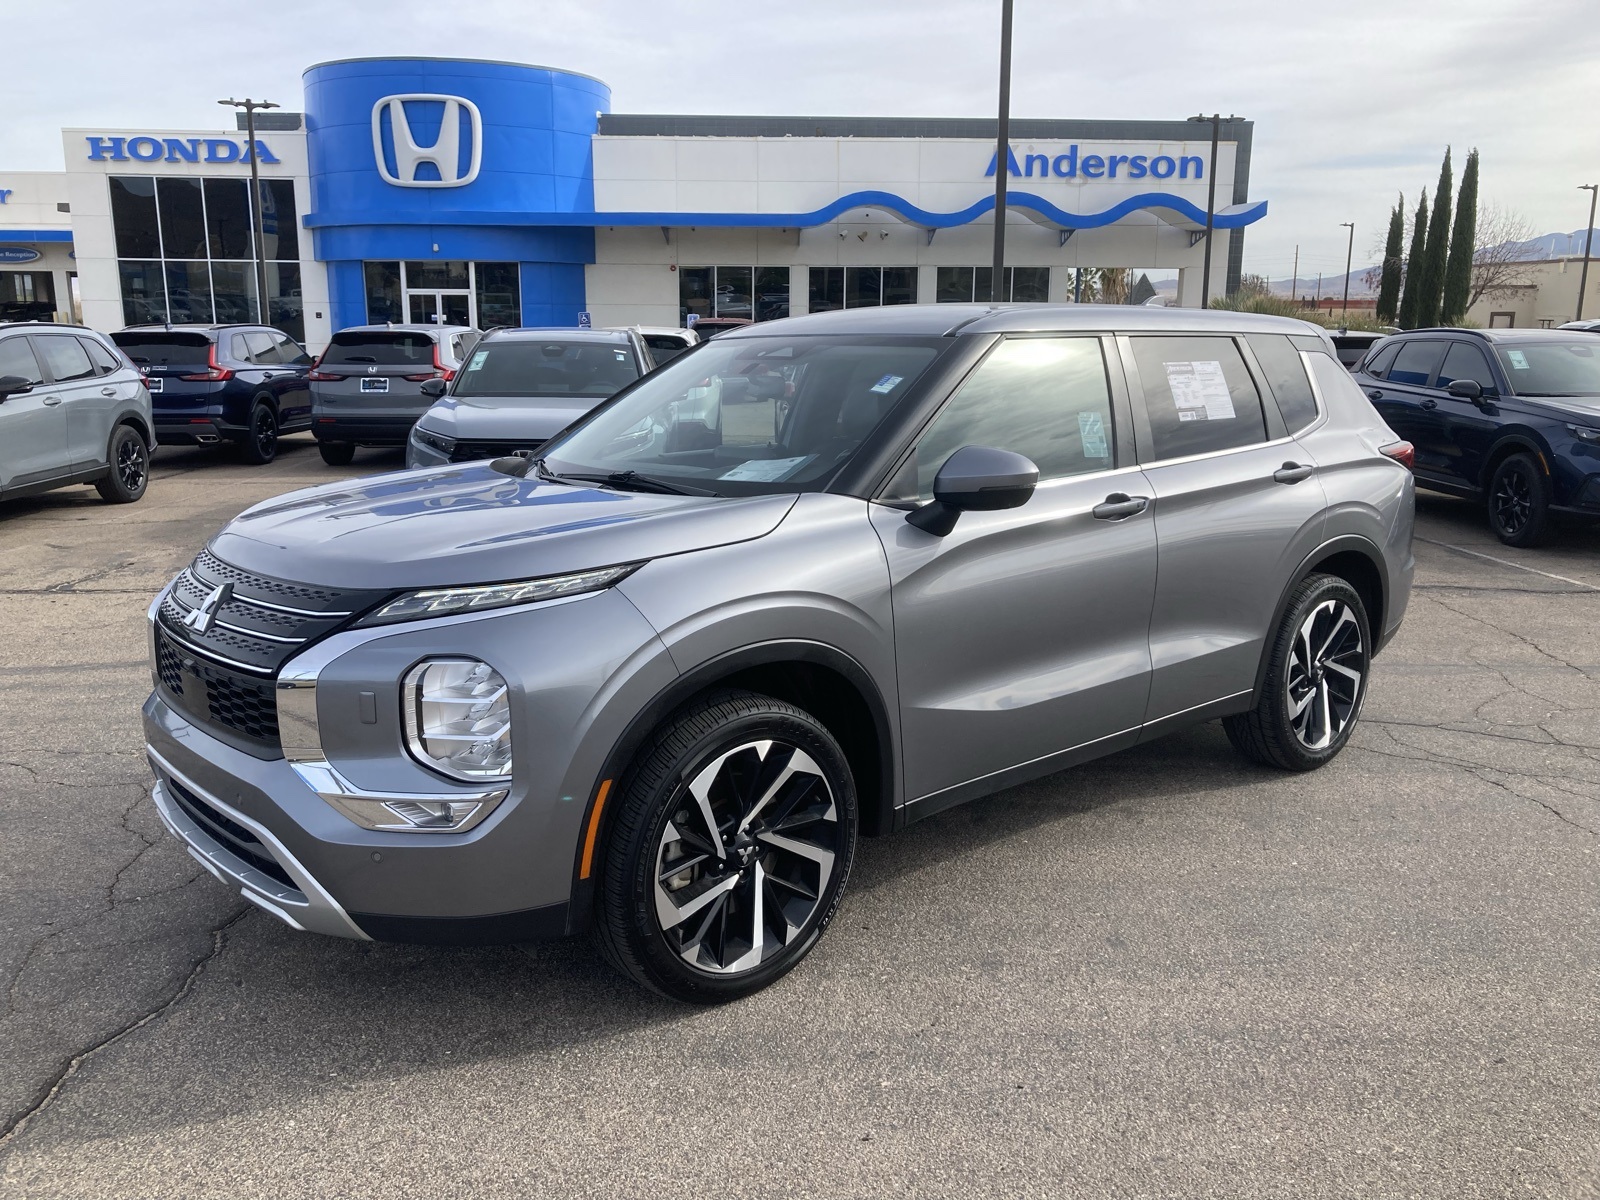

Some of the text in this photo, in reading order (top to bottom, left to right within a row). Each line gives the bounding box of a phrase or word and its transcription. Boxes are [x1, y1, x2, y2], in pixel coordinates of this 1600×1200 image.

[85, 136, 281, 164] HONDA
[984, 144, 1204, 180] Anderson
[5, 251, 36, 259] Reception
